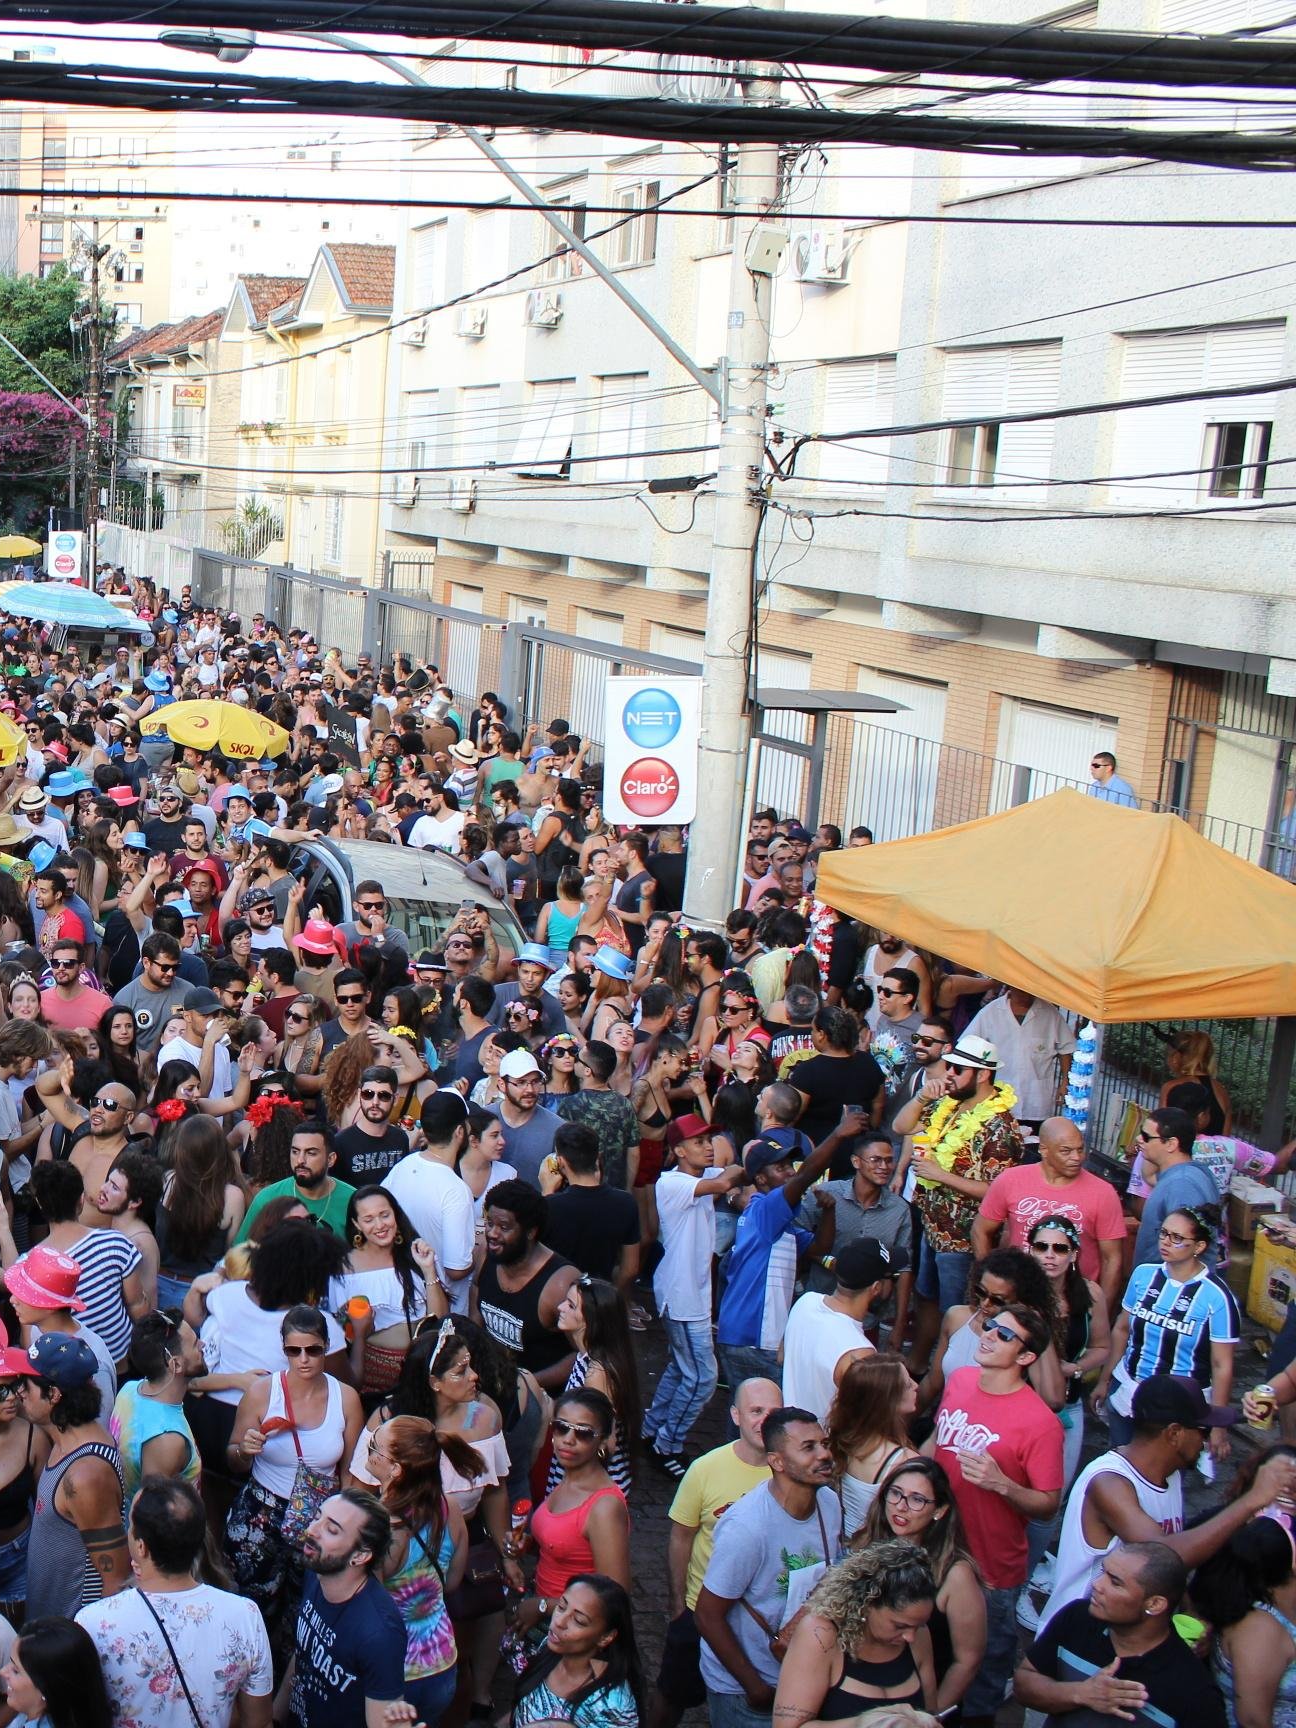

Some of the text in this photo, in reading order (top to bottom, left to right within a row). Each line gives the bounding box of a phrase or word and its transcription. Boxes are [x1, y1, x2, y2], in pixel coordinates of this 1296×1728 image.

[626, 711, 677, 725] NET
[229, 742, 254, 756] SKOL
[623, 777, 672, 795] Claro
[771, 1035, 795, 1059] GUNS
[1131, 1301, 1196, 1336] Banrisul
[303, 1599, 313, 1618] 32
[311, 1635, 357, 1693] COAST
